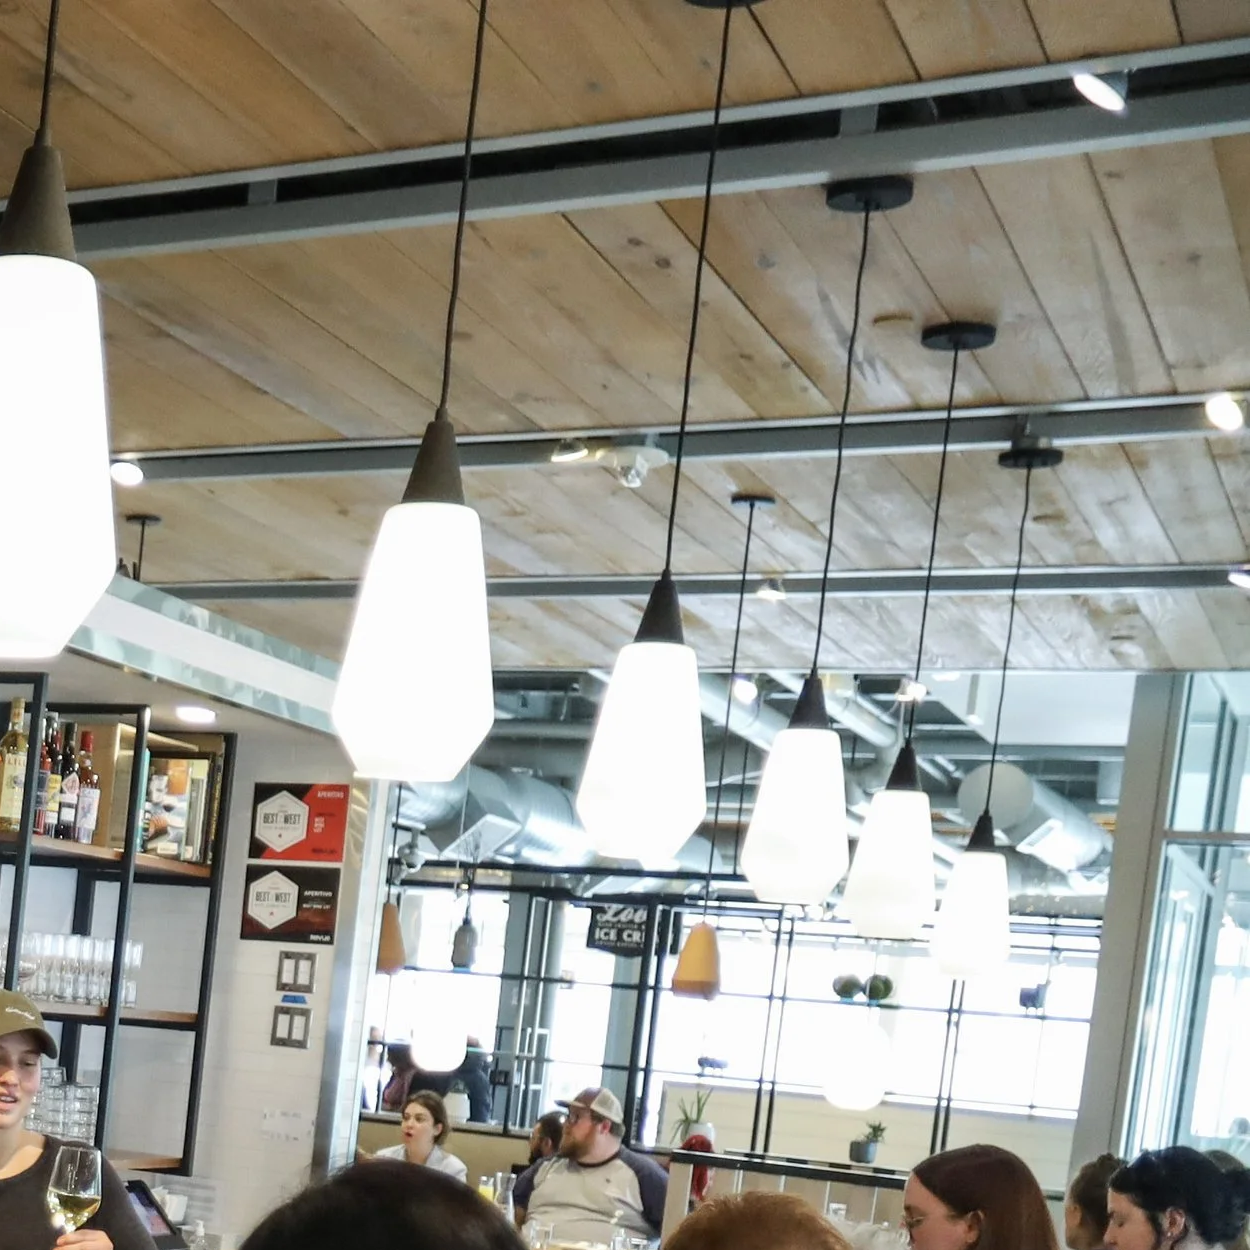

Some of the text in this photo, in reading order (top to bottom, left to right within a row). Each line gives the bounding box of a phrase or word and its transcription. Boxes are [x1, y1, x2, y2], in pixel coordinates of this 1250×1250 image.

[263, 813, 279, 825] BEST
[283, 813, 302, 825] WEST
[255, 891, 291, 903] BEST WEST
[595, 927, 618, 941] ICE
